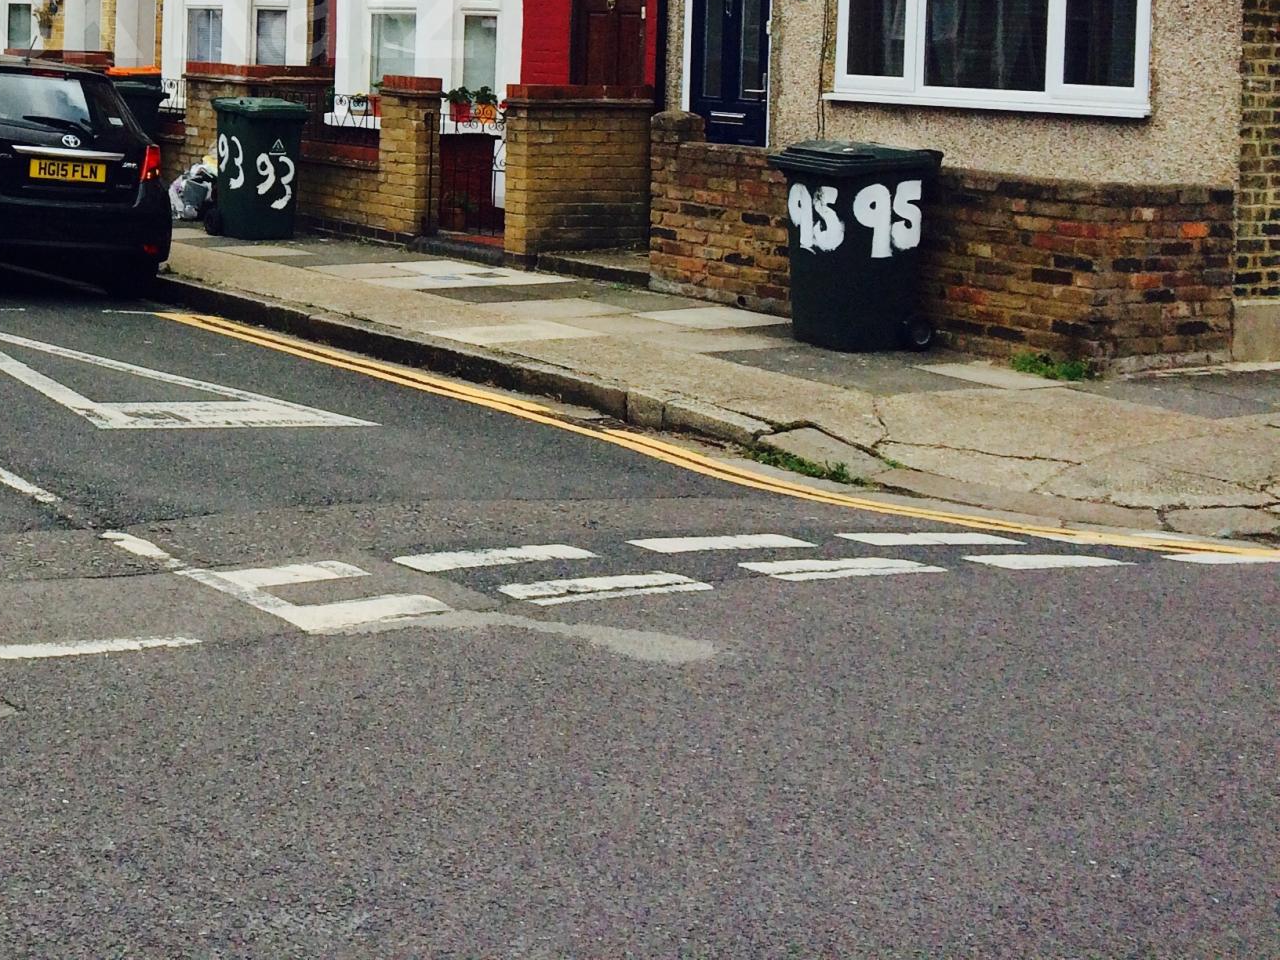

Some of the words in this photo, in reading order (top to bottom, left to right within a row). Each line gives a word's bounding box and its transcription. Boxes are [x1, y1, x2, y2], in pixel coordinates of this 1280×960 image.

[38, 162, 69, 178] HG15
[72, 163, 98, 179] FLN
[218, 133, 245, 189] 93
[256, 153, 295, 210] 93
[787, 183, 845, 254] 95
[853, 180, 922, 258] 95
